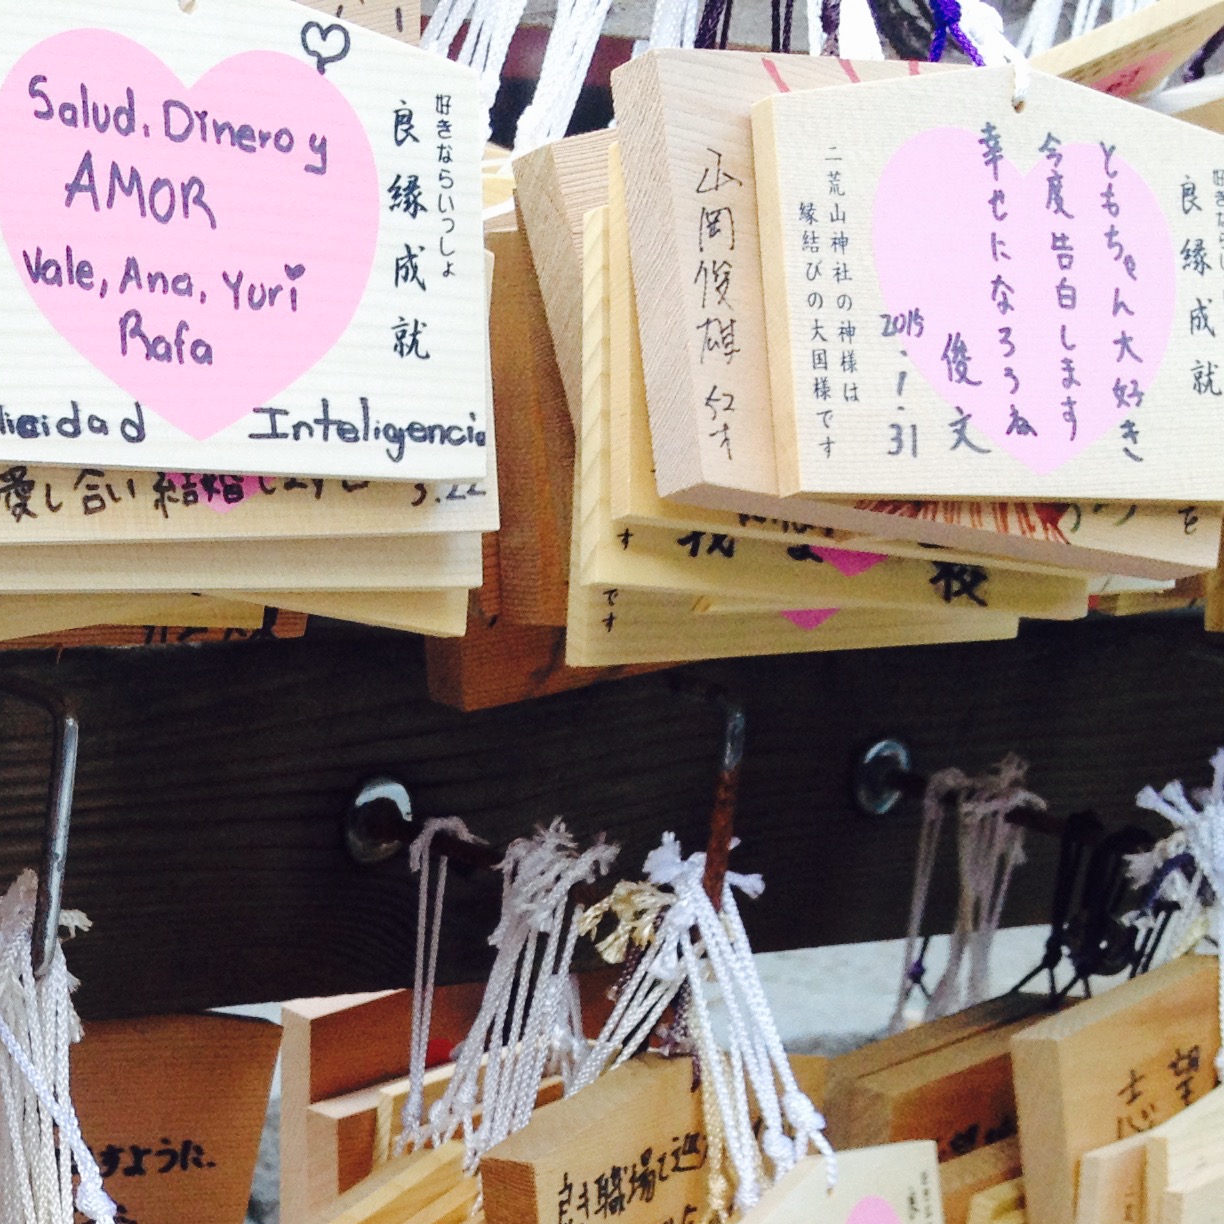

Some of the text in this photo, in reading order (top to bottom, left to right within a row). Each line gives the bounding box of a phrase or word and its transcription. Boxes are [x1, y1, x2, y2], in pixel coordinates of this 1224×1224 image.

[64, 149, 218, 230] AMOR
[162, 99, 295, 154] Dinero
[304, 132, 328, 175] y
[388, 100, 431, 361] 良縁成就
[434, 93, 457, 280] 好きならいっしょ
[118, 308, 214, 365] Rafa
[222, 262, 307, 312] Yuri
[798, 201, 837, 460] 縁結びの大国様です
[824, 146, 860, 403] 二荒山神社の神様は
[978, 121, 1037, 437] 幸せになろうね
[1038, 131, 1082, 442] 今度告白します
[1098, 140, 1145, 462] ともちゃん大好き
[1179, 173, 1223, 397] 良縁成就
